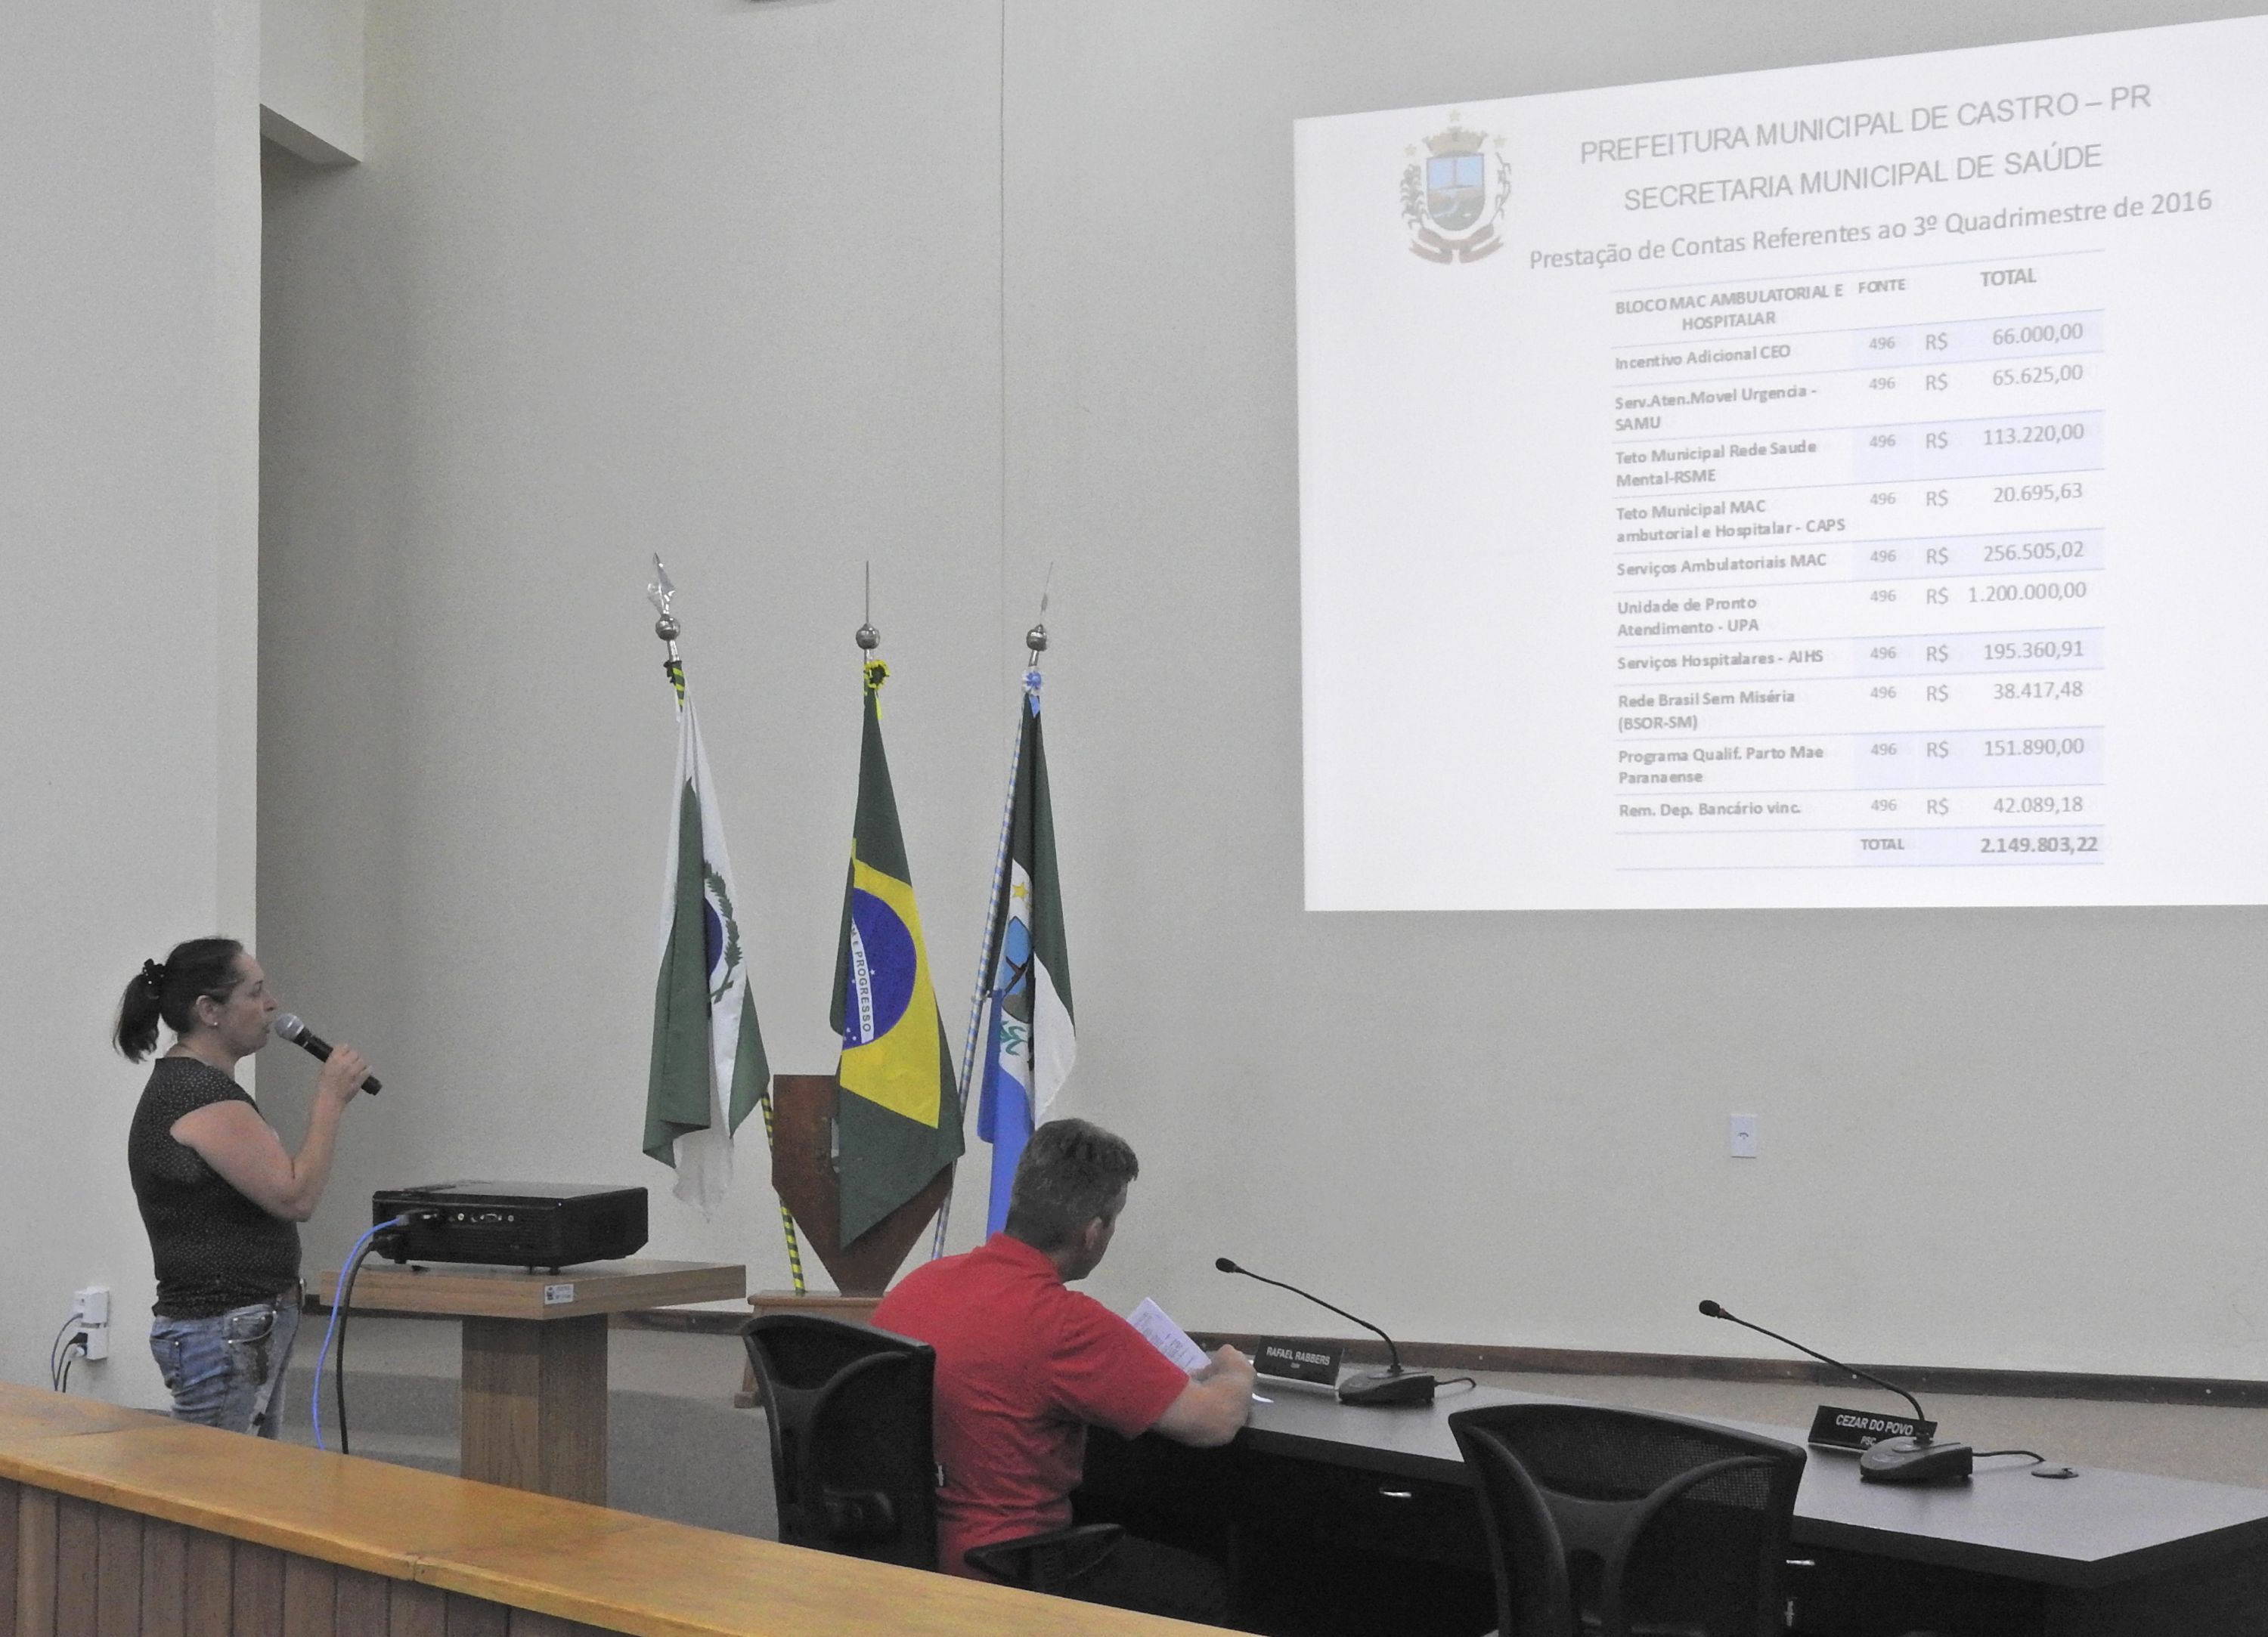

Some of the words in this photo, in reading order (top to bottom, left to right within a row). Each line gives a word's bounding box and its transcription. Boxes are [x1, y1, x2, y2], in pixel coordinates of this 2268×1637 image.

[1581, 125, 1750, 164] PREFEITURA
[1756, 110, 1904, 147] MUNICIPAL
[1911, 105, 1949, 132] DE
[1957, 92, 2079, 126] CASTRO
[2111, 84, 2151, 111] PR
[1625, 174, 1794, 211] SECRETARIA
[1800, 159, 1949, 194] MUNICIPAL
[1957, 154, 1994, 181] DE
[2004, 141, 2102, 175] SAÚDE
[1530, 243, 1632, 269] Prestação
[1637, 240, 1665, 260] de
[1671, 236, 1746, 257] Contas
[1753, 225, 1871, 250] Referentes
[1878, 222, 1907, 240] ao
[1913, 215, 1938, 237] 3º
[1944, 203, 2107, 235] Quadrimestre
[2113, 196, 2144, 218] de
[2151, 189, 2212, 215] 2016
[1616, 298, 1668, 315] BLOCO
[1669, 295, 1706, 310] MAC
[1710, 285, 1830, 307] AMBULATORIAL
[1834, 283, 1843, 298] E
[1858, 278, 1907, 294] FONTE
[1980, 267, 2037, 287] TOTAL
[1682, 311, 1776, 331] HOSPITALAR
[1615, 354, 1683, 370] Incentivo
[1686, 345, 1757, 364] Adicional
[1759, 344, 1791, 360] CEO
[1869, 336, 1896, 350] 496
[1926, 332, 1948, 351] R$
[1993, 323, 2084, 345] 66.000,00
[1615, 388, 1738, 410] Serv.Aten.Movel
[1741, 385, 1808, 404] Urgencia
[1869, 376, 1896, 390] 496
[1926, 372, 1948, 391] R$
[1992, 364, 2084, 386] 65.625,00
[1615, 416, 1662, 432] SAMU
[1615, 451, 1647, 465] Teto
[1651, 444, 1725, 463] Municipal
[1729, 442, 1768, 457] Rede
[1769, 439, 1817, 455] Saude
[1869, 434, 1896, 448] 496
[1926, 431, 1949, 450] R$
[1984, 422, 2085, 446] 113.220,00
[1616, 469, 1716, 487] Mental-RSME
[1616, 507, 1648, 520] Teto
[1652, 500, 1726, 518] Municipal
[1730, 499, 1766, 514] MAC
[1870, 492, 1897, 506] 496
[1926, 488, 1949, 508] R$
[1994, 482, 2083, 503] 20.695,63
[1616, 525, 1699, 543] ambutorial
[1701, 528, 1711, 538] e
[1715, 521, 1792, 540] Hospitalar
[1805, 518, 1846, 533] CAPS
[1616, 562, 1678, 577] Serviços
[1681, 555, 1786, 573] Ambulatoriais
[1790, 552, 1827, 568] MAC
[1870, 549, 1897, 563] 496
[1926, 546, 1949, 565] R$
[1984, 540, 2084, 562] 256.505,02
[1617, 599, 1679, 614] Unidade
[1683, 598, 1702, 611] de
[1705, 597, 1758, 611] Pronto
[1870, 589, 1897, 602] 496
[1926, 586, 1949, 605] R$
[1969, 581, 2087, 603] 1.200.000,00
[1617, 621, 1715, 636] Atendimento
[1727, 618, 1759, 632] UPA
[1617, 656, 1678, 672] Serviços
[1681, 651, 1776, 670] Hospitalares
[1787, 649, 1824, 664] AIHS
[1870, 646, 1898, 660] 496
[1926, 644, 1949, 664] R$
[1984, 640, 2084, 661] 195.360,91
[1618, 694, 1655, 708] Rede
[1658, 692, 1699, 707] Brasil
[1703, 692, 1736, 705] Sem
[1739, 689, 1796, 704] Miséria
[1870, 685, 1897, 699] 496
[1926, 684, 1949, 703] R$
[1994, 680, 2084, 700] 38.417,48
[1618, 714, 1698, 733] (BSOR-SM)
[1619, 750, 1689, 766] Programa
[1692, 746, 1743, 763] Qualif.
[1746, 747, 1786, 760] Parto
[1789, 745, 1825, 759] Mae
[1870, 743, 1898, 756] 496
[1926, 740, 1950, 759] R$
[1984, 738, 2085, 757] 151.890,00
[1619, 771, 1704, 784] Paranaense
[1619, 804, 1656, 817] Rem.
[1660, 803, 1693, 818] Dep.
[1698, 801, 1764, 815] Bancário
[1766, 801, 1802, 815] vinc.
[1870, 799, 1898, 812] 496
[1927, 797, 1950, 816] R$
[1993, 796, 2084, 815] 42.089,18
[1860, 838, 1905, 851] TOTAL
[1980, 836, 2099, 856] 2.149.803,22
[855, 951, 872, 1032] PROGRESSO
[1266, 1346, 1294, 1360] RAFAEL
[1294, 1351, 1331, 1366] RABBERS
[1836, 1414, 1868, 1428] CEZAR
[1869, 1419, 1885, 1431] DO
[1885, 1421, 1913, 1435] POVO
[1861, 1435, 1876, 1446] PSC
